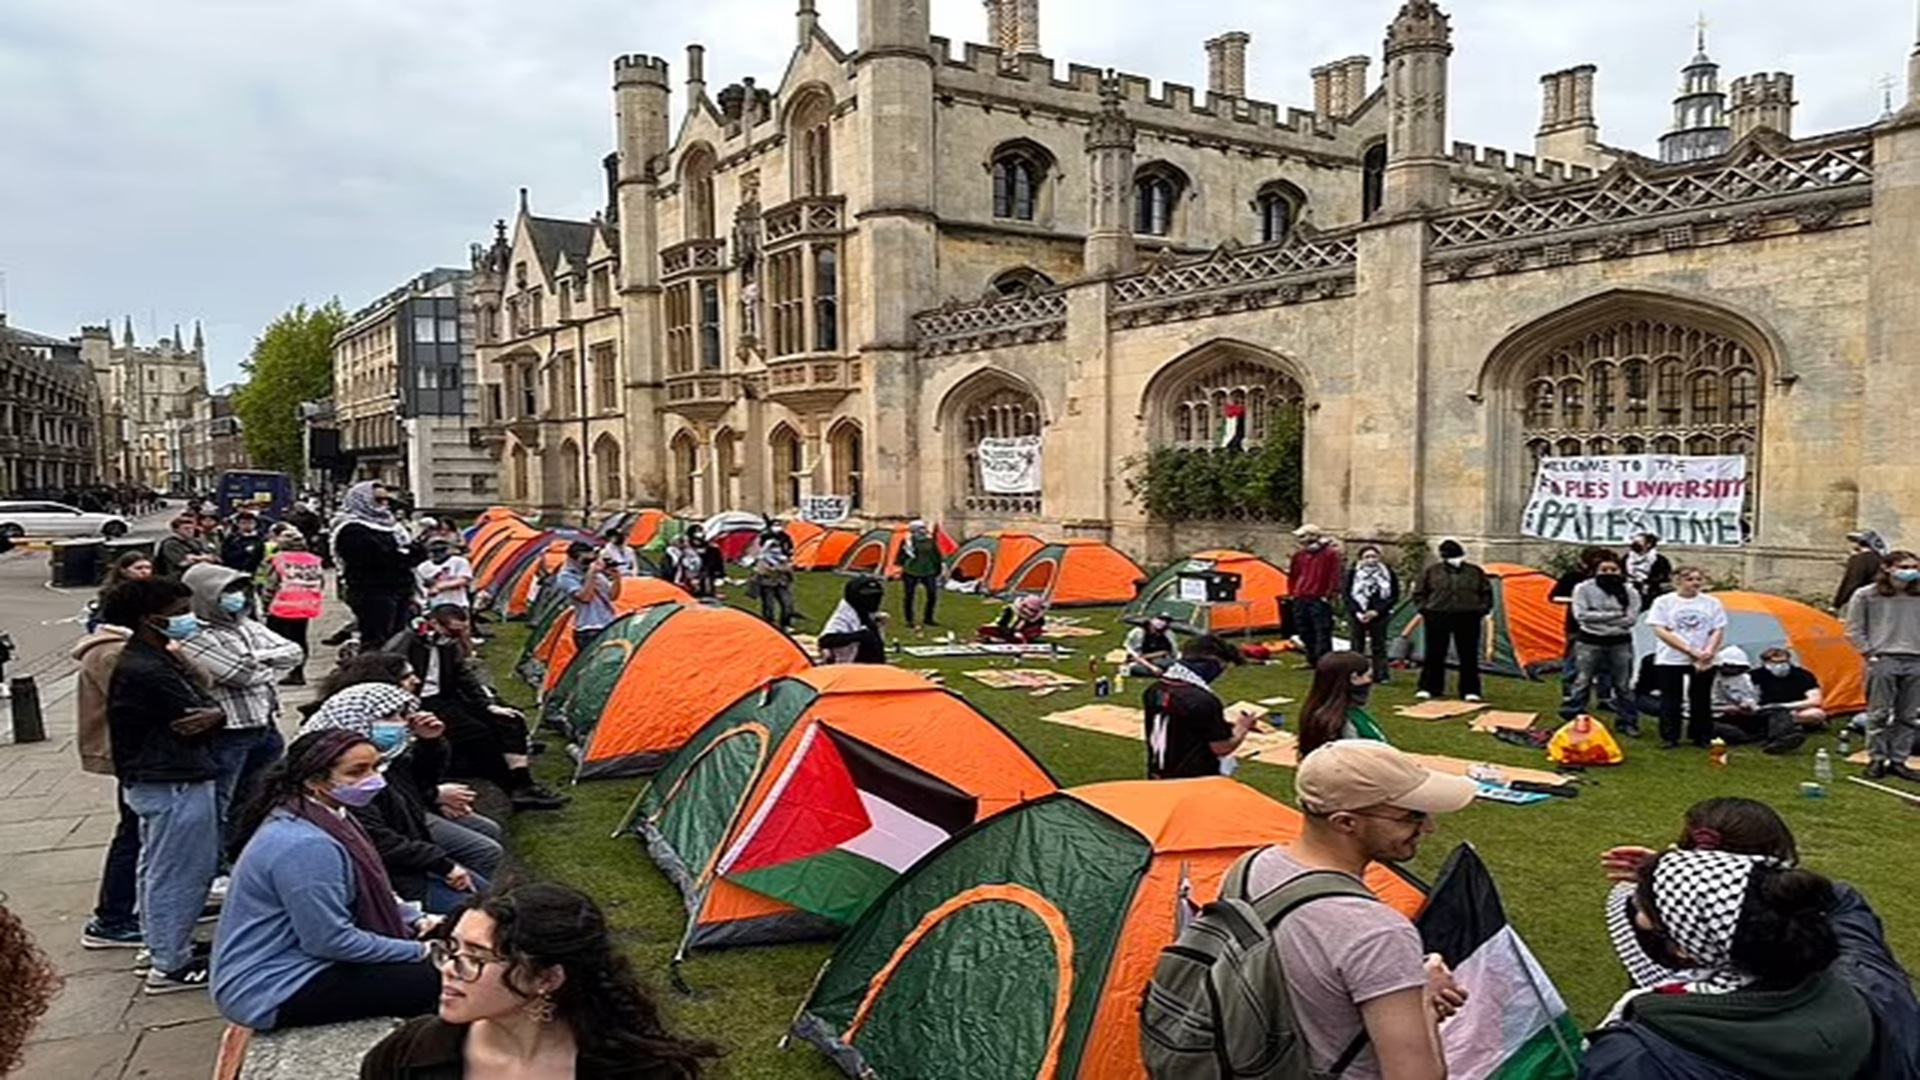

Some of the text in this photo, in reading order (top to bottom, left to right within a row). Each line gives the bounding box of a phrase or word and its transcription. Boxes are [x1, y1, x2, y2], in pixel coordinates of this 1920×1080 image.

[1619, 460, 1641, 472] TO
[1623, 477, 1747, 498] UNIVERSITY
[1537, 500, 1740, 545] PALESTINE
